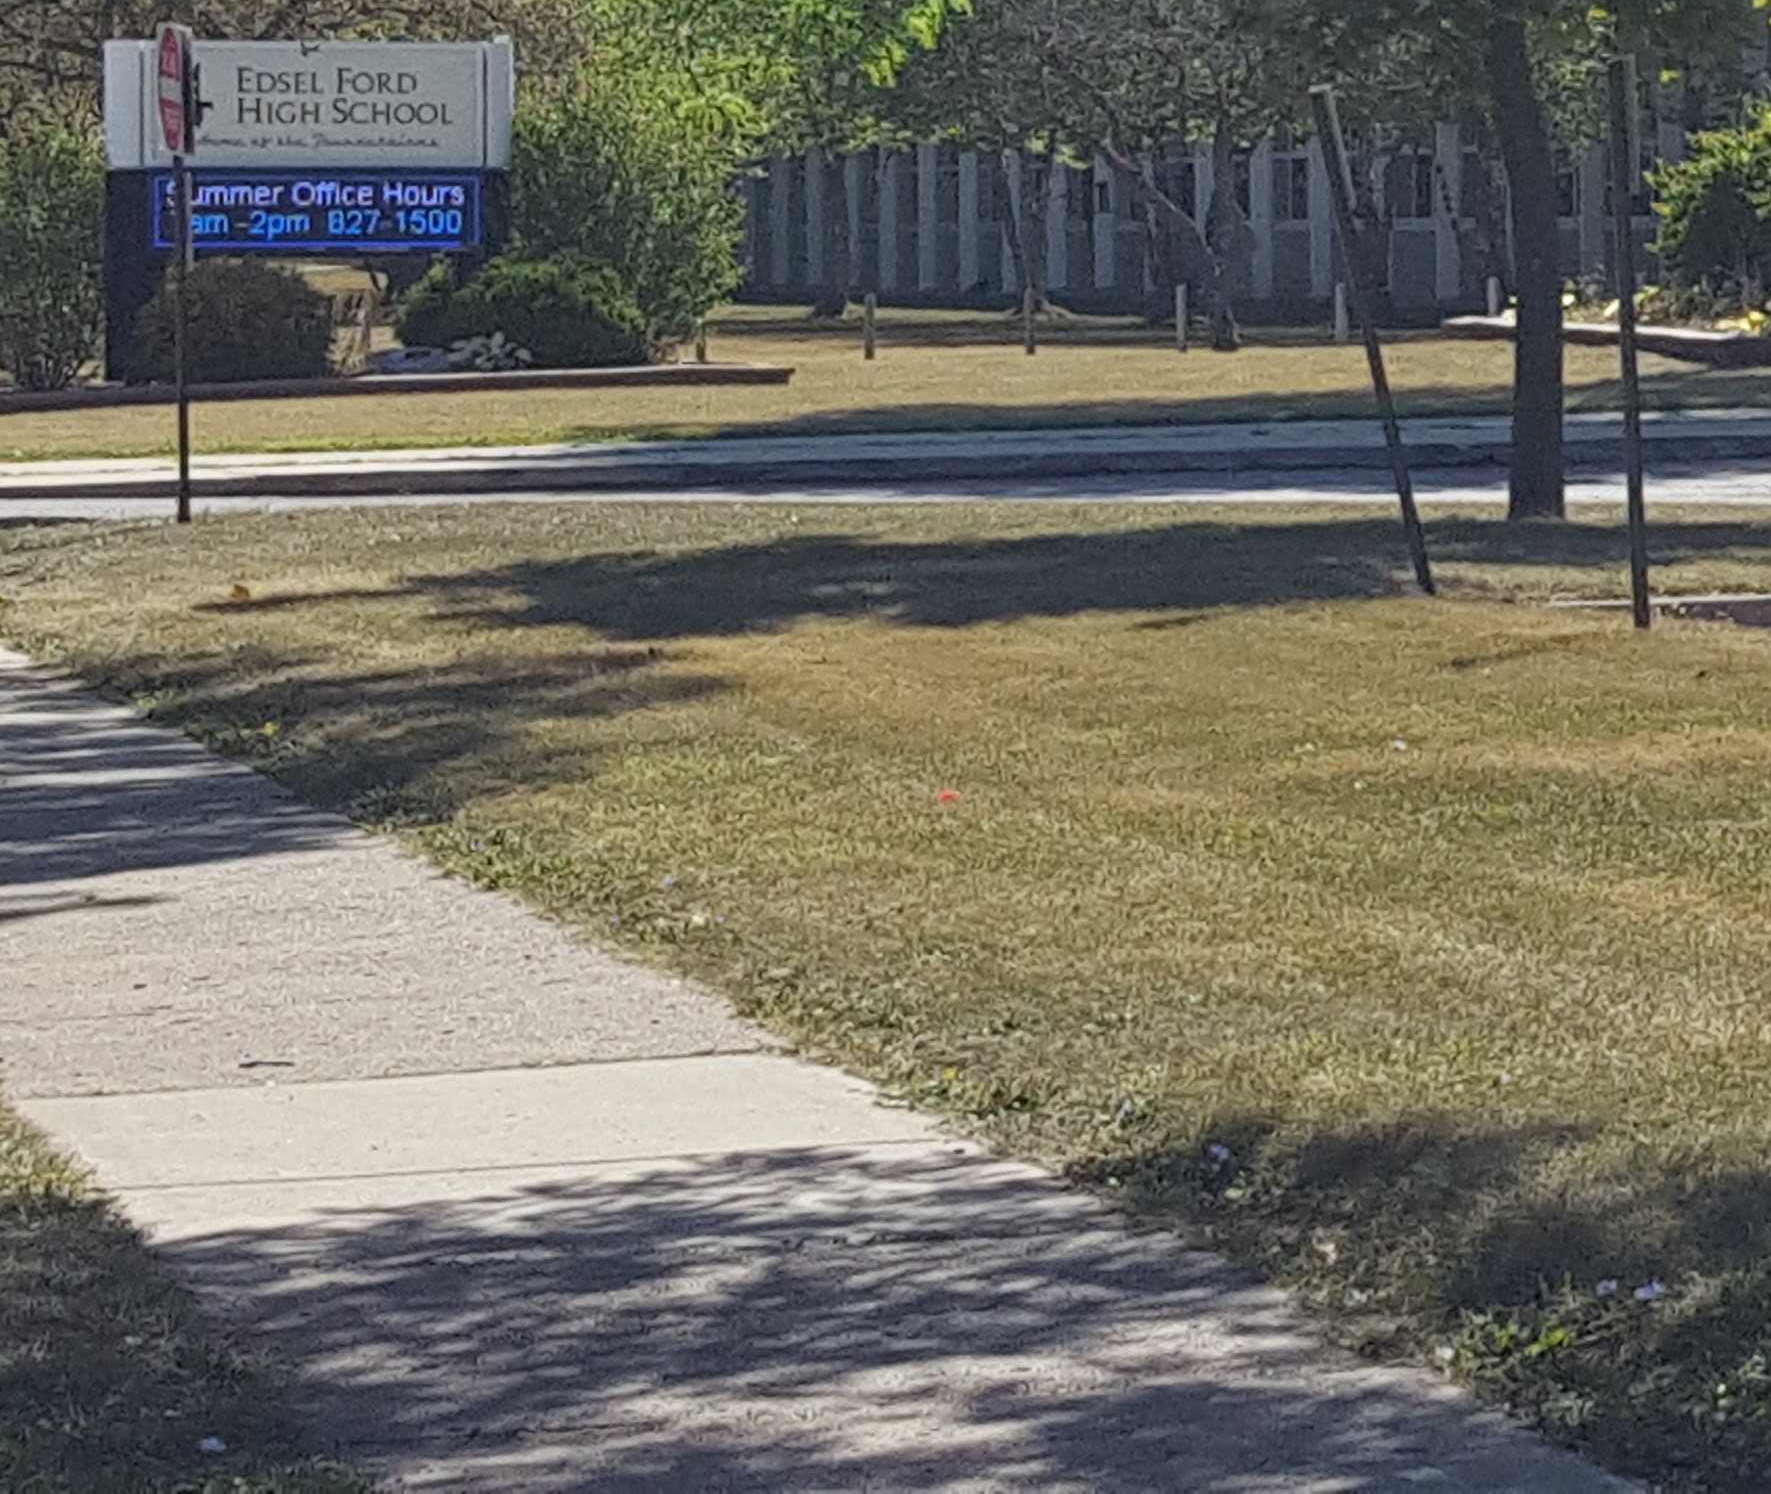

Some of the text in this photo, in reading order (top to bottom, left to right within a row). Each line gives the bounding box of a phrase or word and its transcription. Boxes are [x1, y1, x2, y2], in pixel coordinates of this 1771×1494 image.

[236, 66, 418, 94] EDSEL FORD
[236, 97, 453, 125] HIGH SCHOOL
[292, 181, 374, 206] Office
[383, 180, 465, 206] Hours
[327, 209, 462, 235] 827-1500
